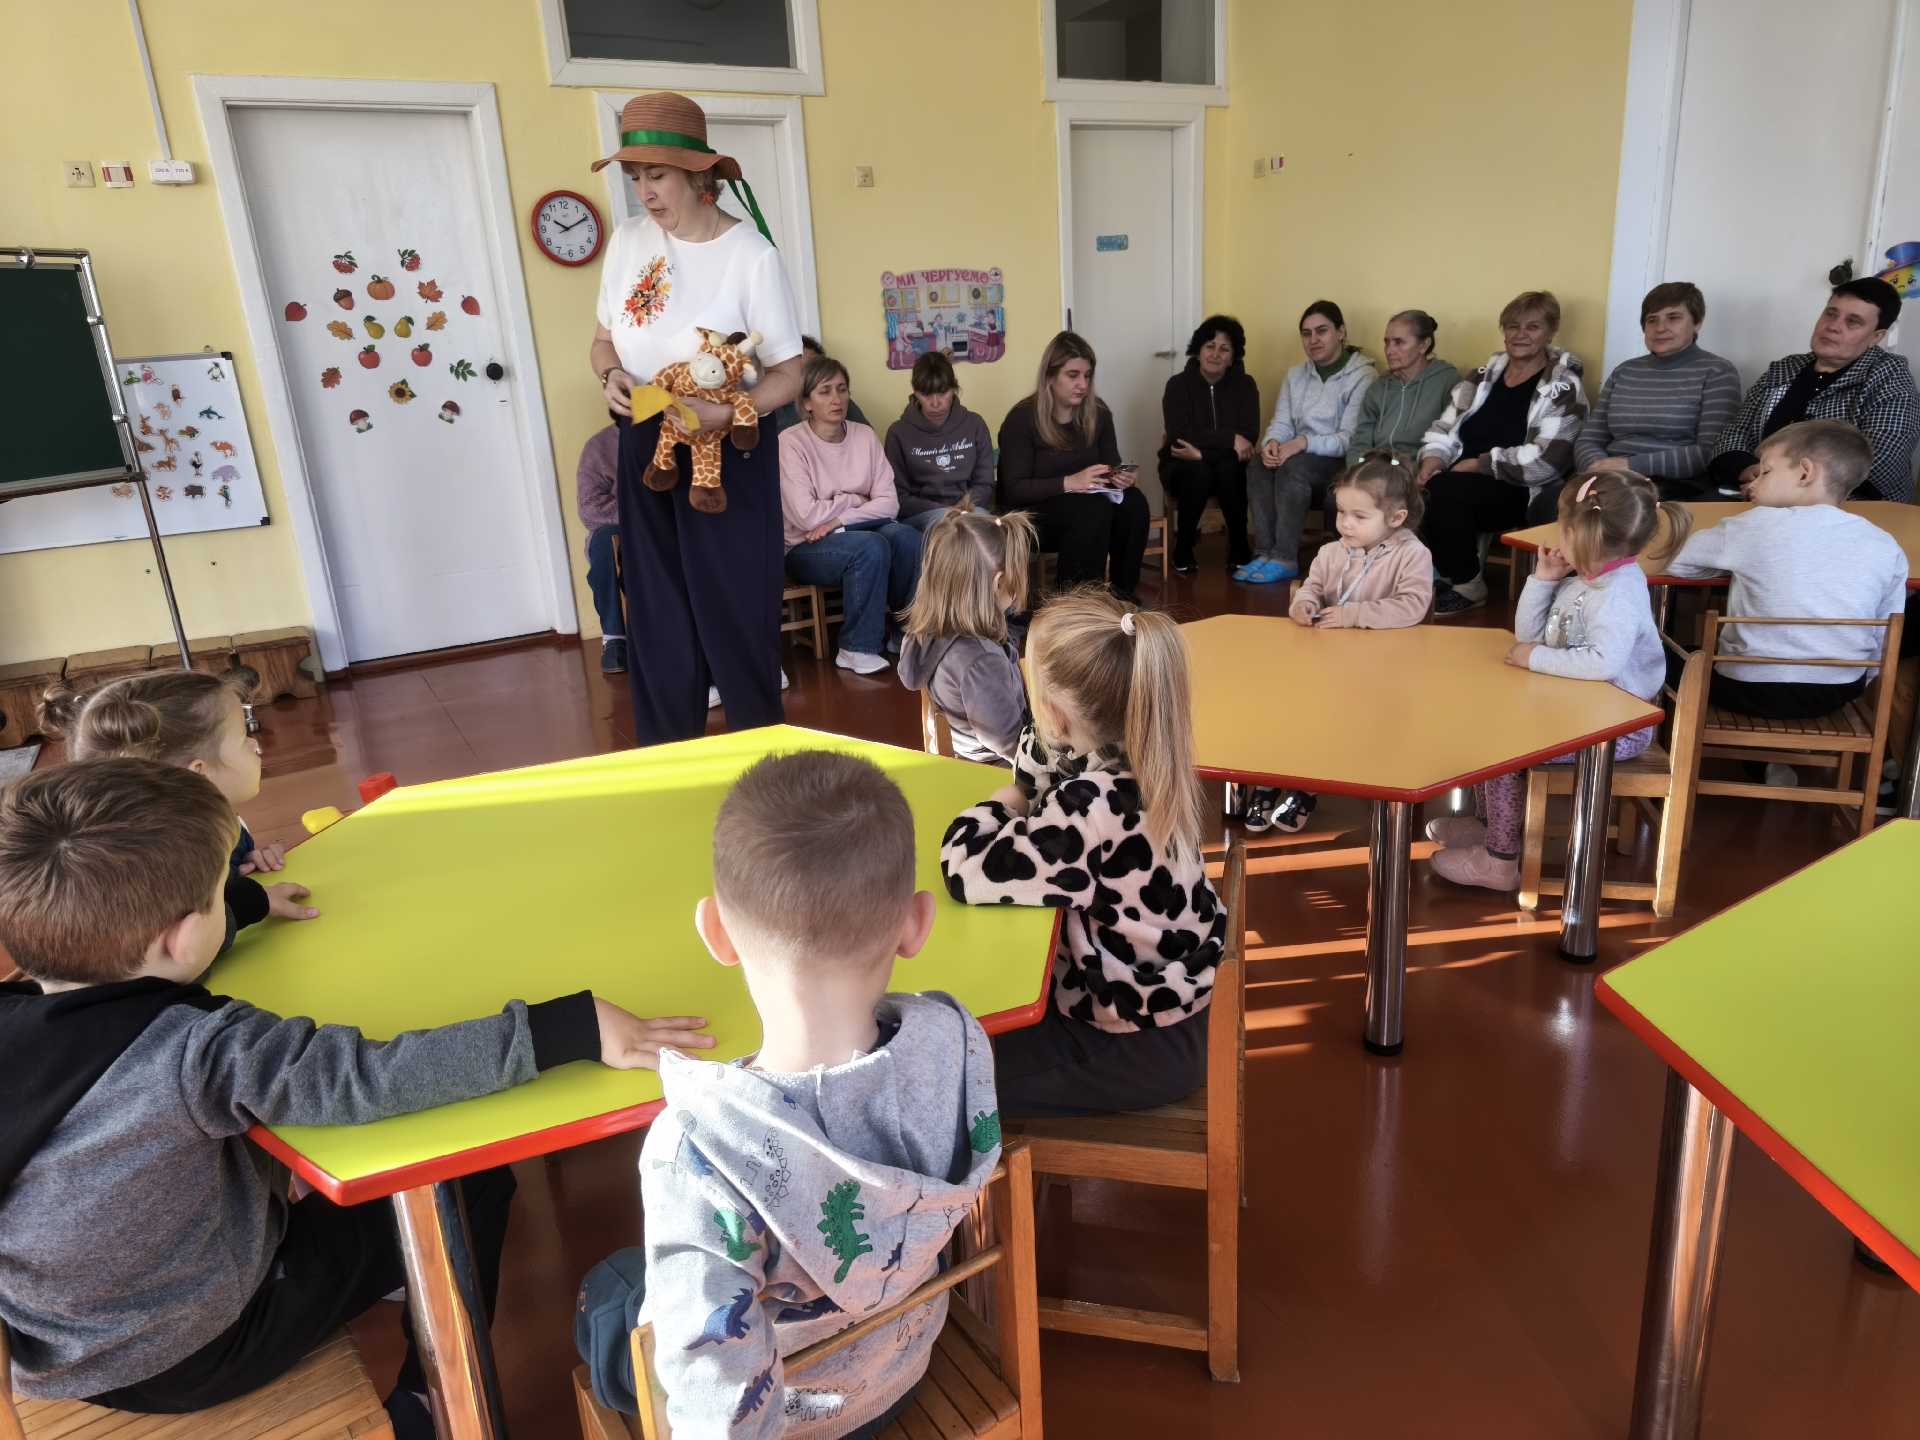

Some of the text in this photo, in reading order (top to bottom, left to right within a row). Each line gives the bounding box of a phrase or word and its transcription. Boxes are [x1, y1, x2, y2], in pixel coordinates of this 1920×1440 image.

[559, 201, 568, 209] 12
[542, 214, 550, 222] 10
[546, 238, 552, 246] 8
[580, 246, 585, 254] 5
[896, 270, 989, 288] МИ ЧЕРГУЄМО
